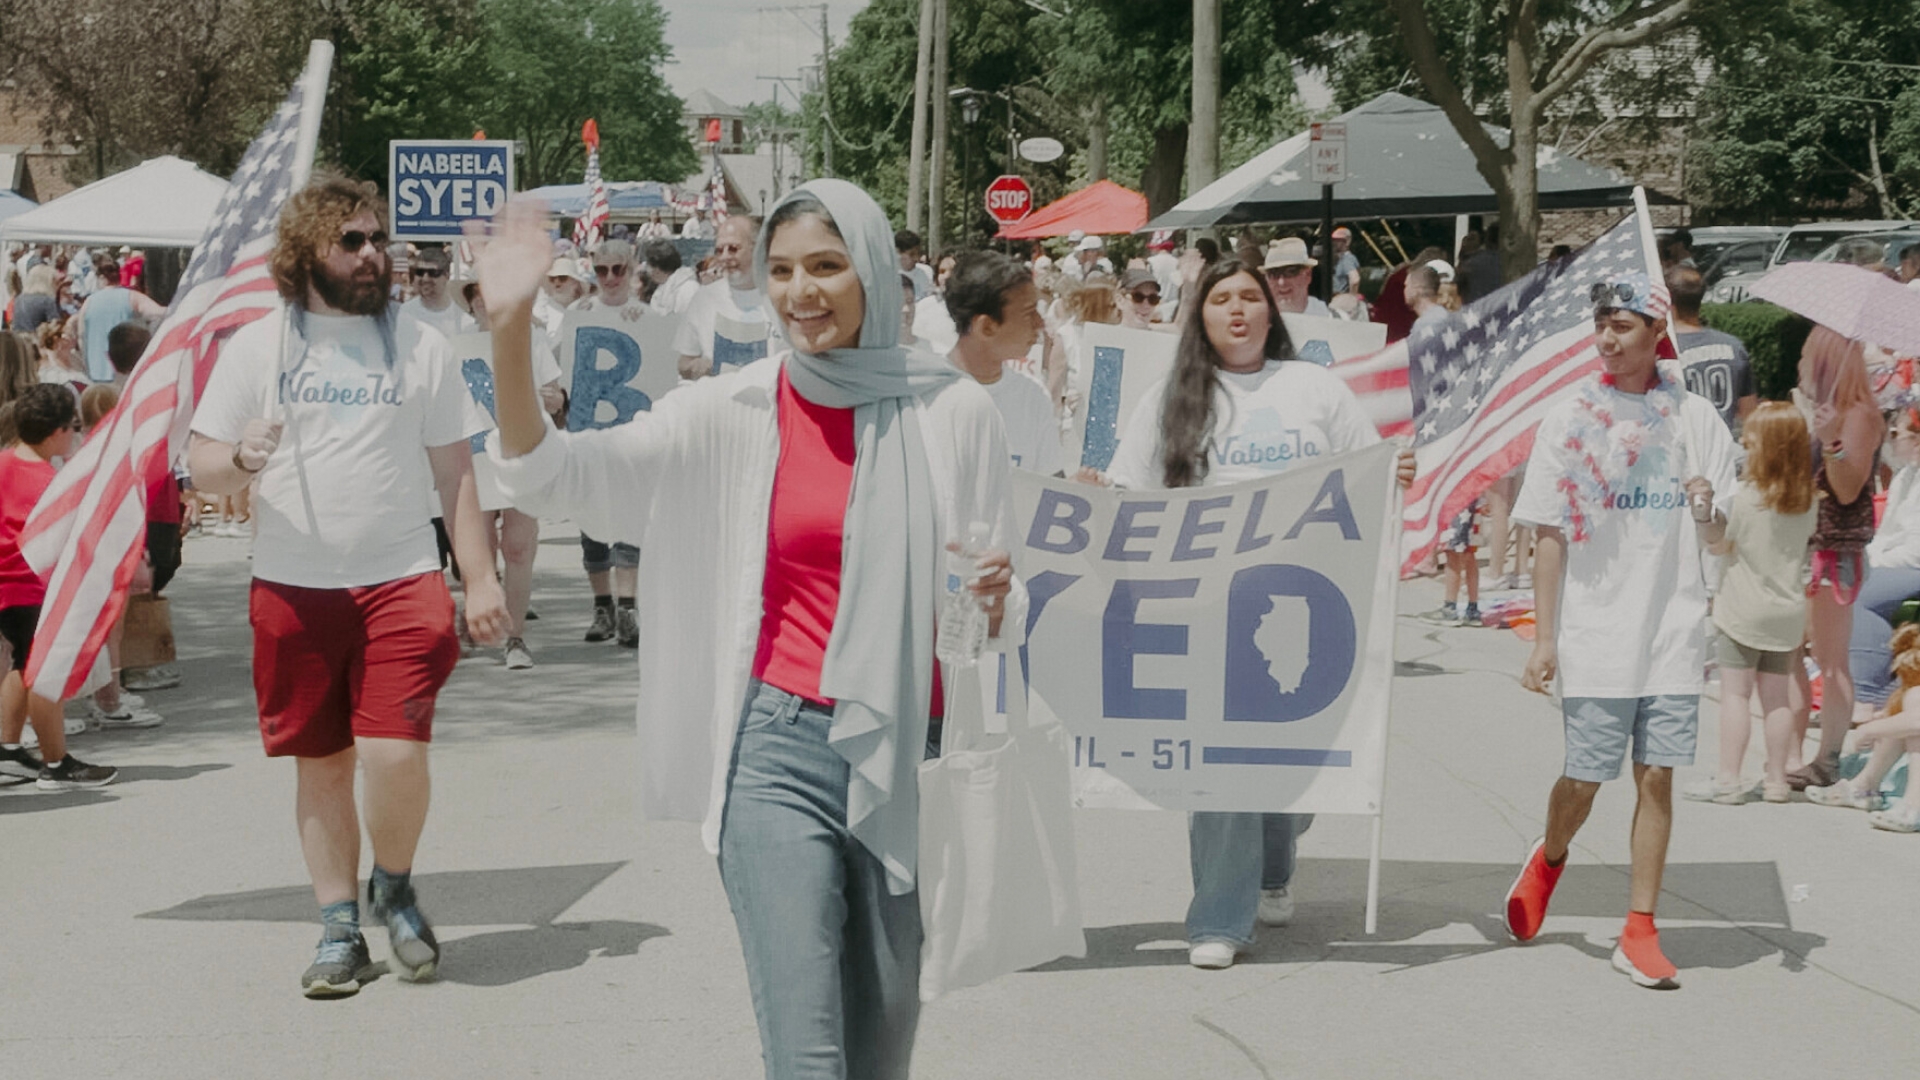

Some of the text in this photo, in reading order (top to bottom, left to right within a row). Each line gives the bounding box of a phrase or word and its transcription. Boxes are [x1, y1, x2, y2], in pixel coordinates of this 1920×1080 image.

[399, 153, 504, 175] NABEELA
[398, 178, 506, 216] SYED
[990, 189, 1028, 209] STOP
[567, 326, 652, 432] B
[1026, 468, 1363, 562] BEELA
[1074, 736, 1106, 768] IL
[1153, 739, 1192, 770] 51
